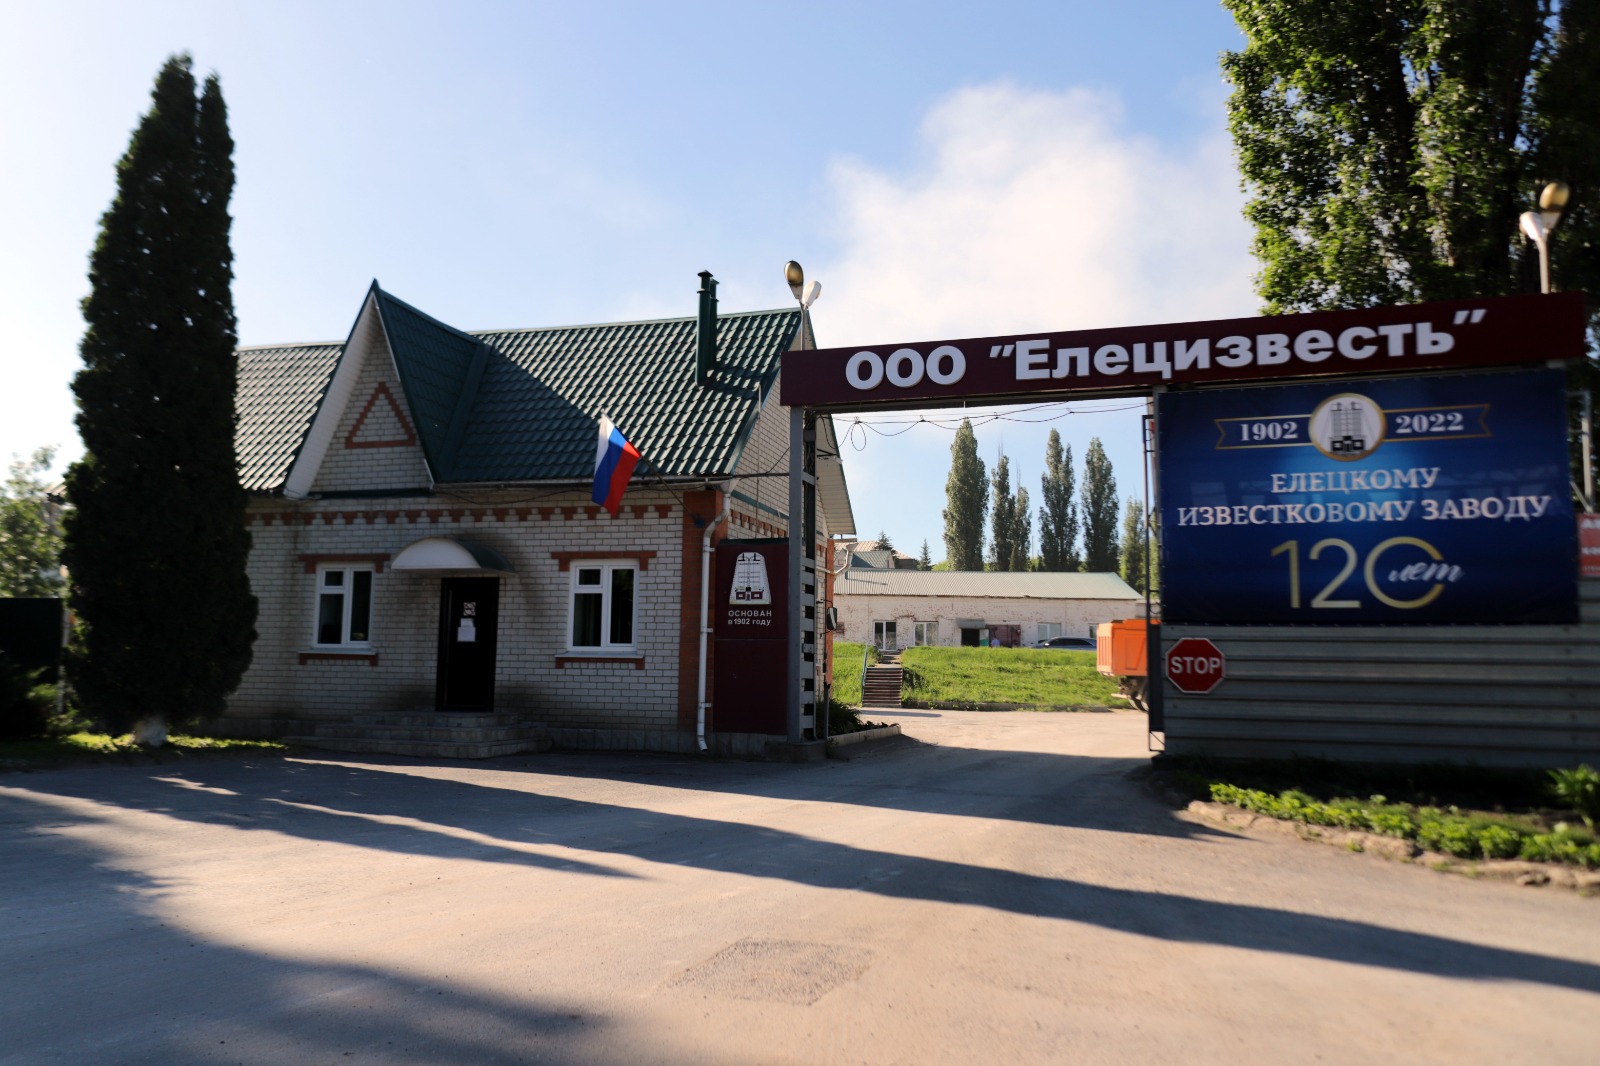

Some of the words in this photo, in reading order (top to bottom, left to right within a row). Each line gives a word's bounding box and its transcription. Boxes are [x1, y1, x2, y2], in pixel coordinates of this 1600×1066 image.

[845, 345, 967, 391] ООО
[989, 308, 1487, 379] "Елецизвесть"
[1240, 421, 1298, 442] 1902
[1395, 413, 1464, 435] 2022
[1270, 467, 1441, 495] ЕЛЕЦКОМУ
[1177, 499, 1414, 526] ИЗВЕСТКОВОМУ
[1421, 495, 1551, 522] ЗАВОДУ
[1270, 536, 1446, 610] 120
[1388, 560, 1463, 583] лет
[728, 610, 772, 618] ОСНОВАН
[1170, 656, 1221, 675] STOP
